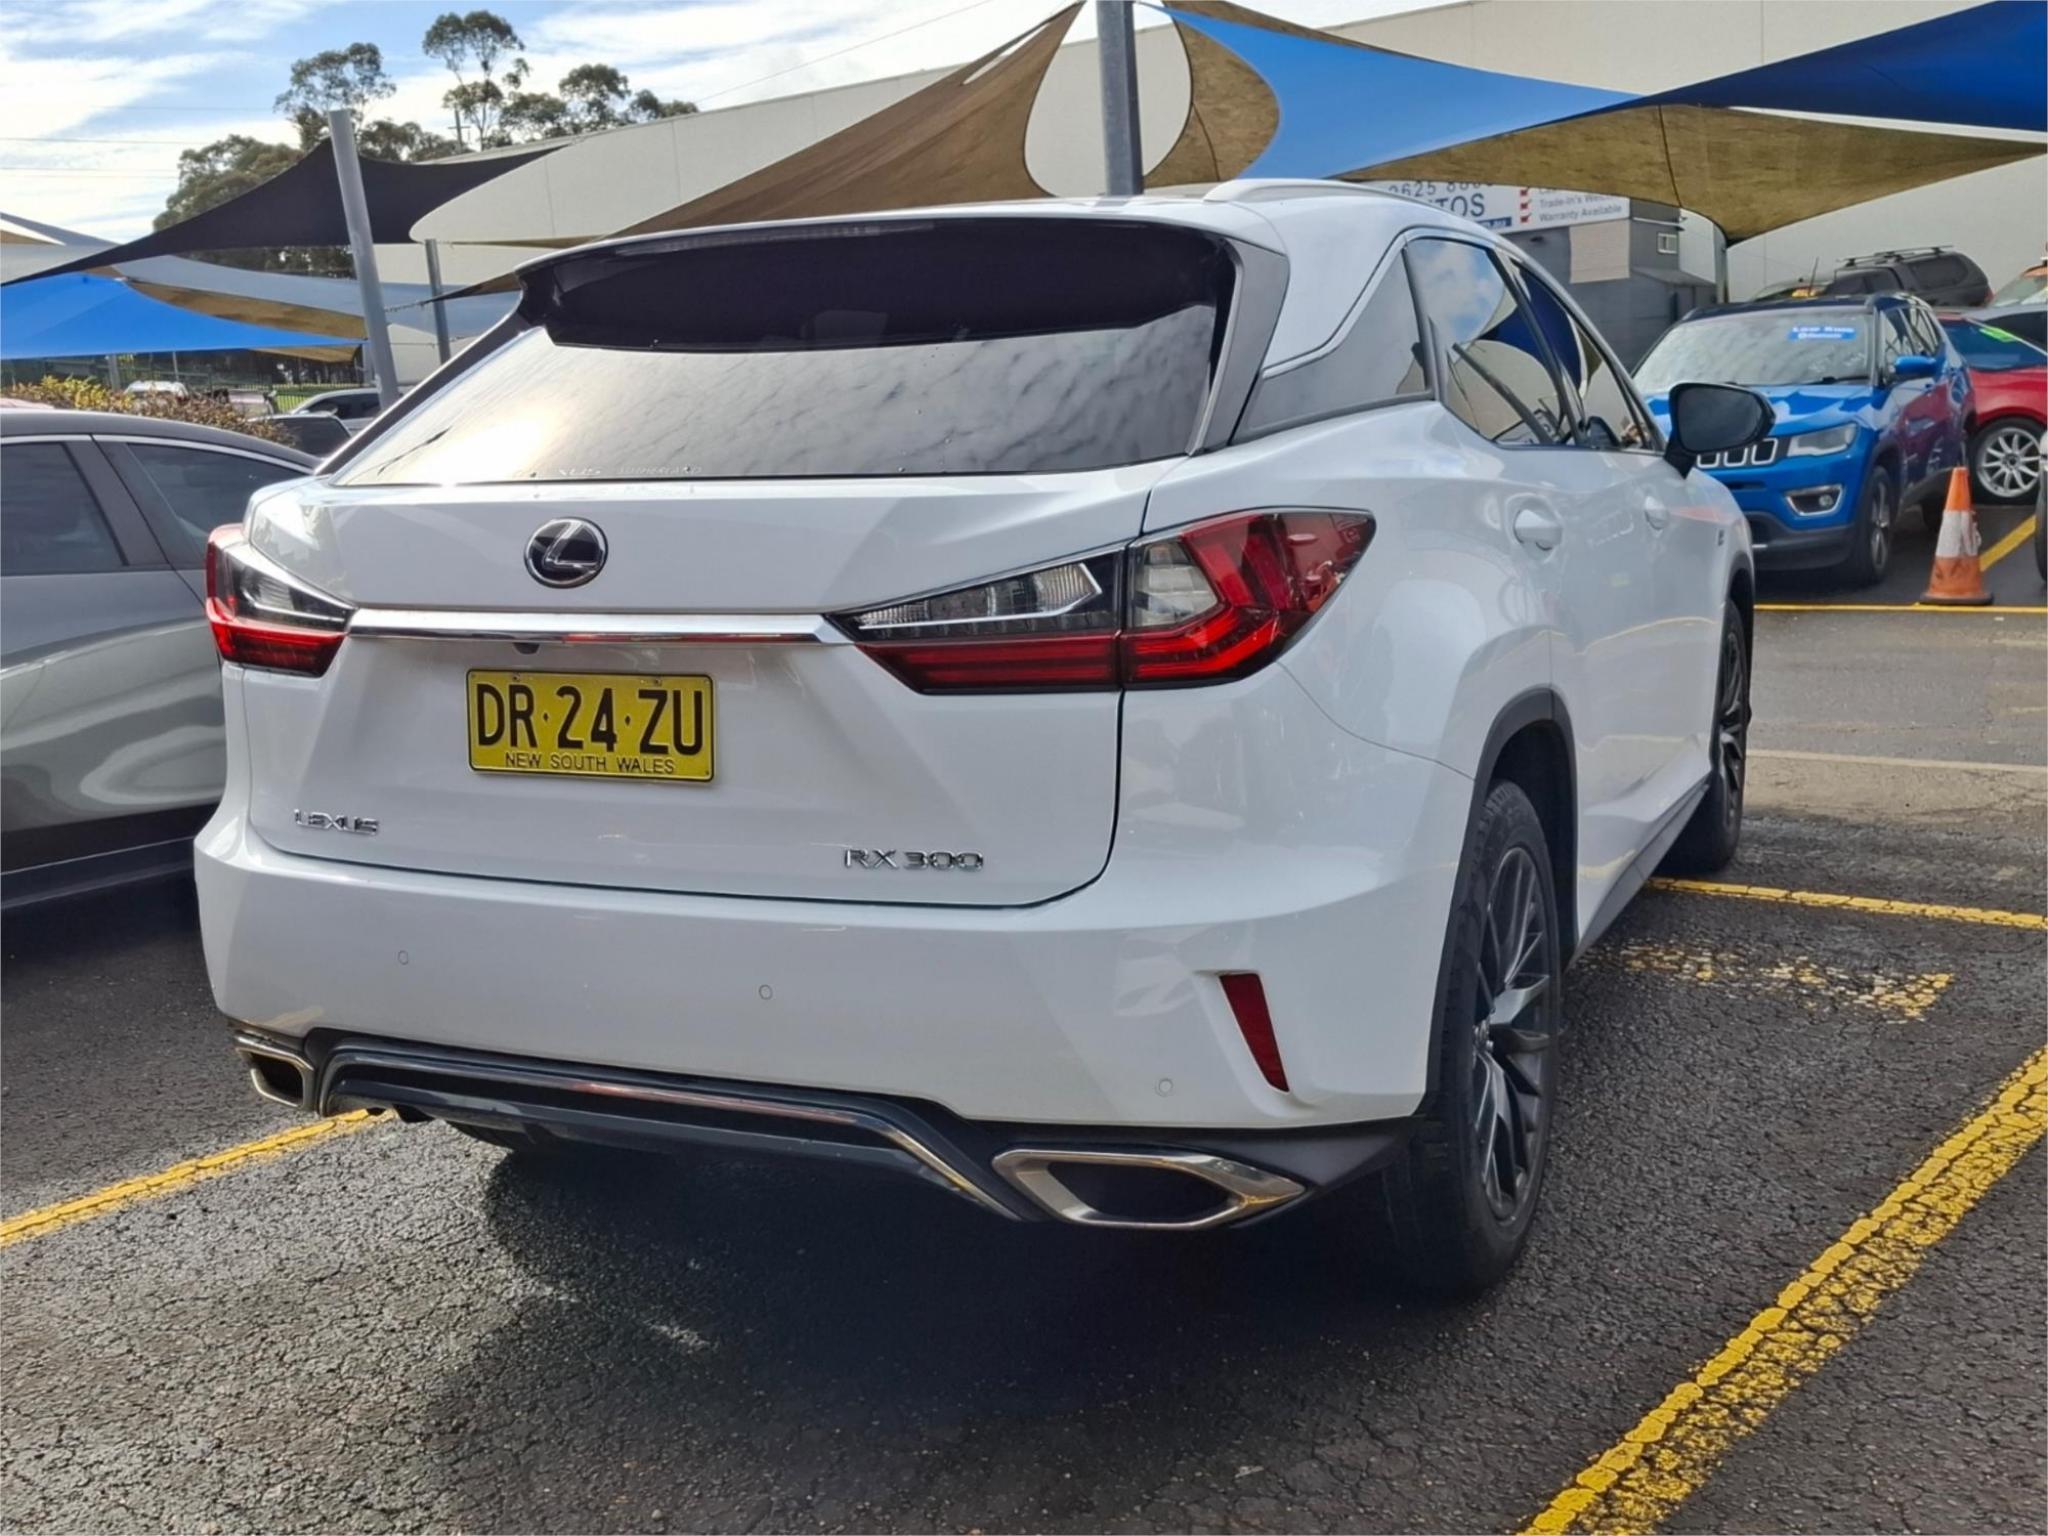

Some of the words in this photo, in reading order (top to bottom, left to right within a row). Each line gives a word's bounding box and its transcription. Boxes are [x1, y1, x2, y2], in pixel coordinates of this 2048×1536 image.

[1539, 210, 1579, 221] Warranty
[1582, 205, 1622, 216] Available
[505, 752, 541, 768] NEW
[550, 754, 606, 772] SOUTH
[617, 756, 676, 774] WALES
[293, 808, 379, 836] LEXUS
[844, 849, 899, 869] RX
[903, 851, 984, 873] 300
